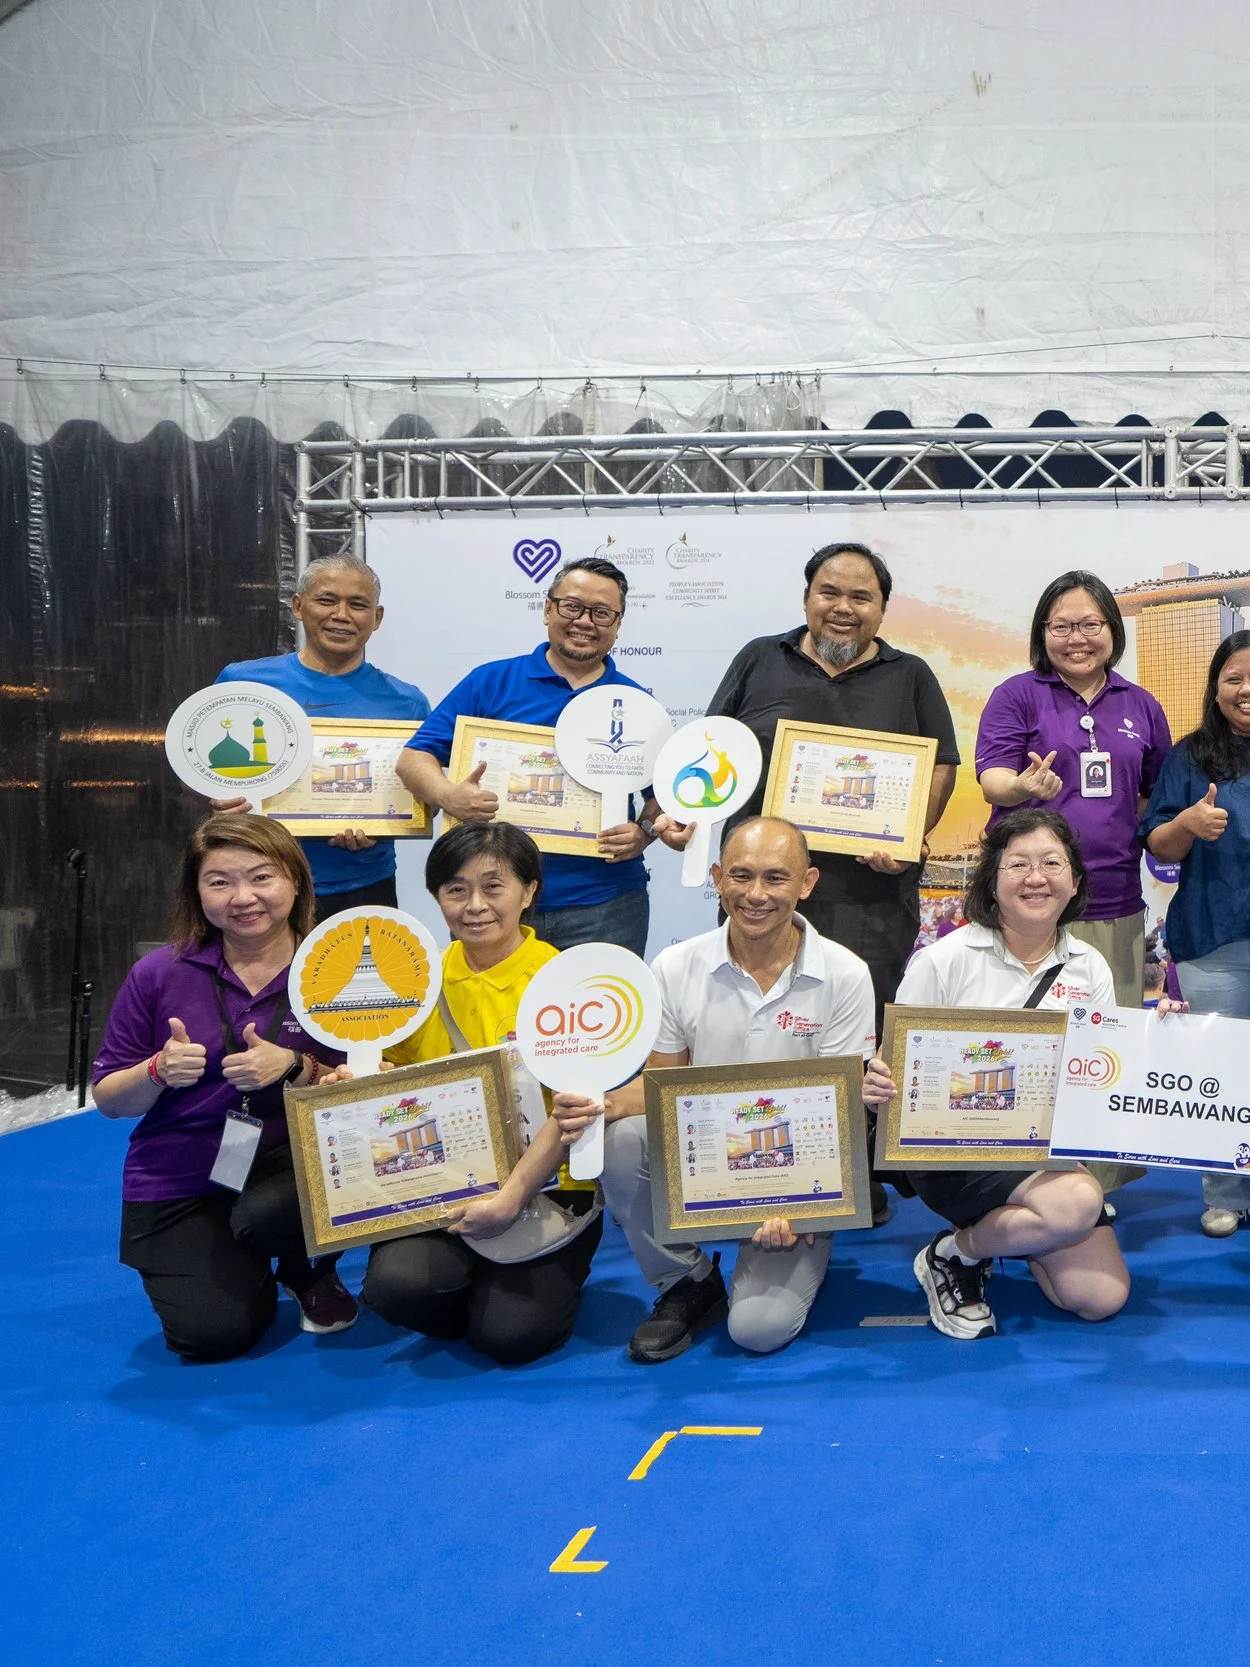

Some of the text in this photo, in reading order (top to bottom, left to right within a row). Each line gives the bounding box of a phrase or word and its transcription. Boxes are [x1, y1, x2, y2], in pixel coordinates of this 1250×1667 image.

[505, 590, 540, 599] Blossom
[620, 647, 662, 656] HONOUR
[197, 697, 236, 718] PETEMPATAN
[237, 696, 265, 705] MELAYU
[265, 702, 294, 734] SEMBAWANG
[666, 708, 706, 716] Social Polic
[587, 753, 644, 763] ASSYAFAAH
[203, 771, 221, 783] JALAN
[341, 1014, 389, 1022] ASSOCIATION
[1102, 1016, 1119, 1024] Cares
[535, 1040, 565, 1048] agency
[534, 1045, 598, 1057] integrated care
[1146, 1072, 1220, 1099] SGO @
[1123, 1153, 1137, 1161] Serve
[1147, 1155, 1159, 1163] Love
[1169, 1157, 1181, 1165] Care
